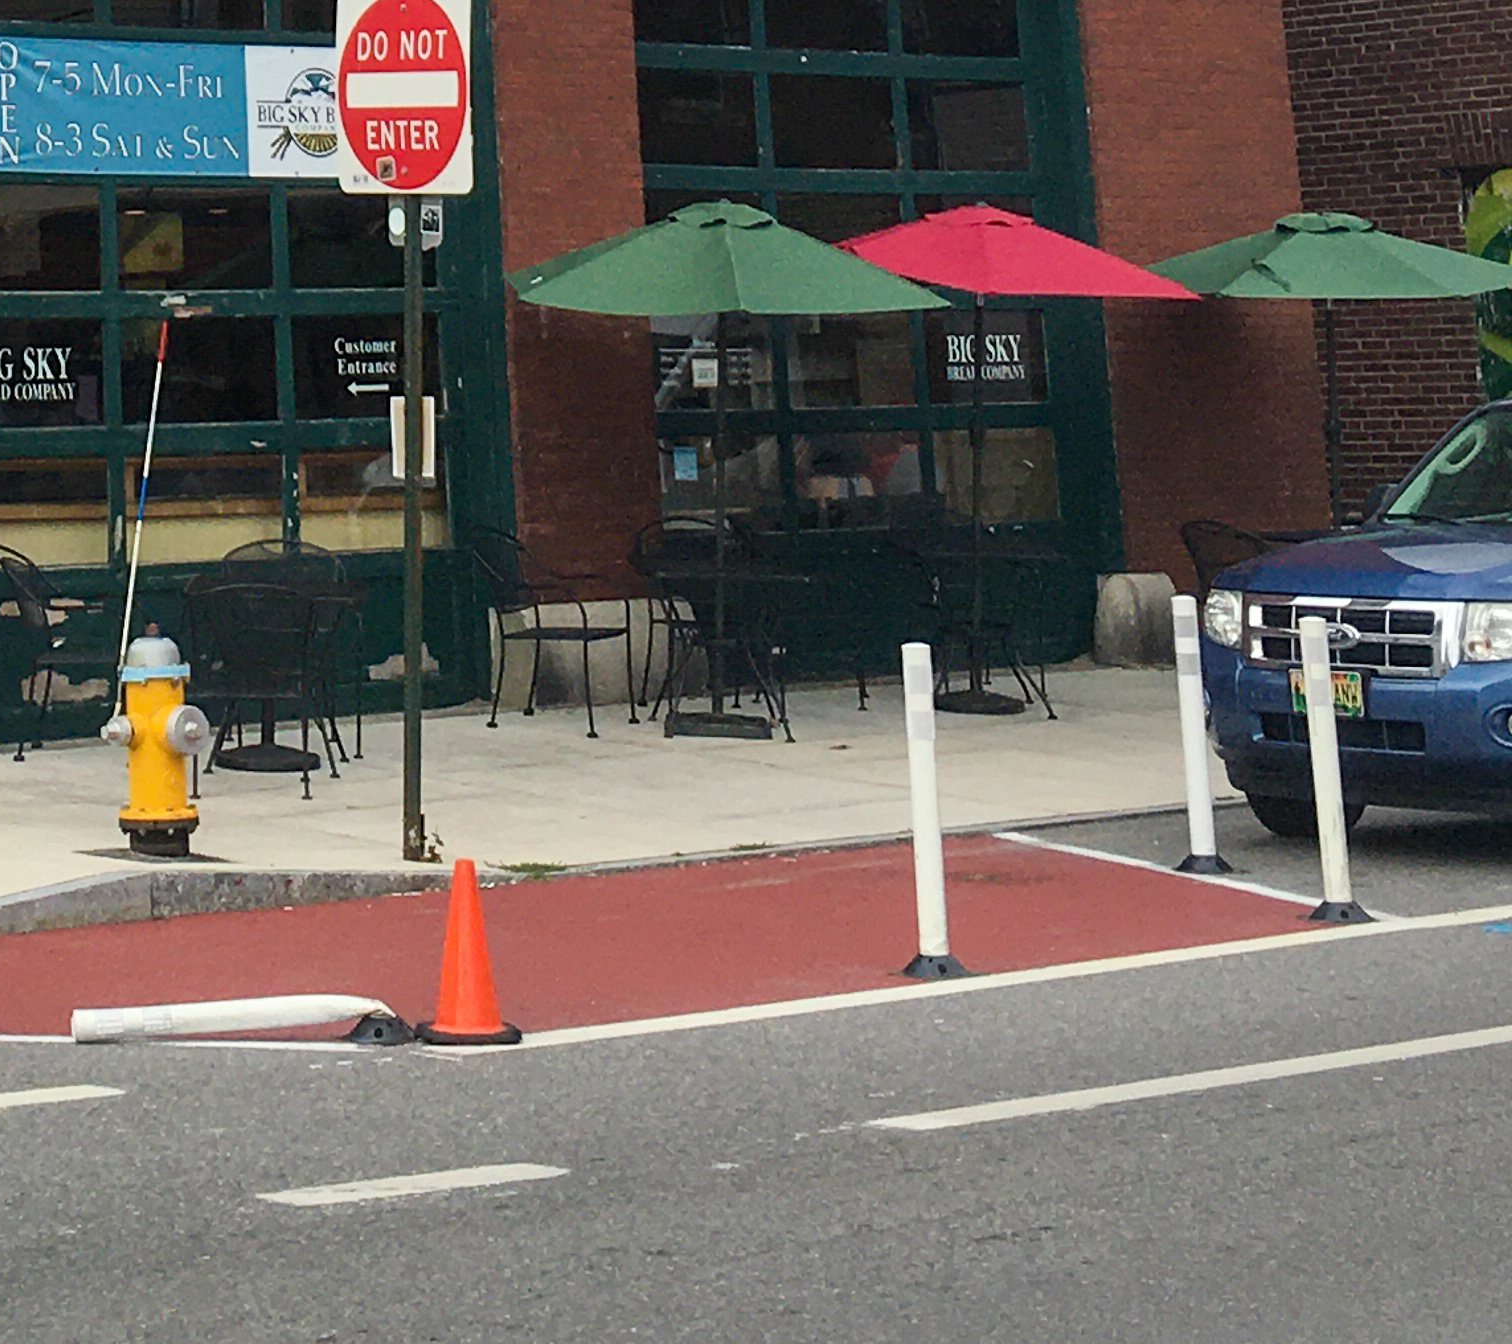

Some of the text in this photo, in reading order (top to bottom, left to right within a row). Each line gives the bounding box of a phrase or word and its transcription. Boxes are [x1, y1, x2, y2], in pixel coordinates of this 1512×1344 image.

[356, 29, 448, 61] DO NOT
[33, 60, 82, 95] 7-5
[257, 104, 285, 123] BIG
[287, 105, 322, 124] SKY
[294, 124, 336, 132] COMPAN
[366, 119, 440, 151] ENTER
[35, 123, 83, 157] 8-3
[155, 136, 174, 159] &
[334, 337, 396, 354] Customer
[985, 334, 1021, 363] SKY
[22, 346, 72, 381] SKY
[337, 358, 396, 376] Entrance
[980, 364, 1025, 380] COMPANY
[14, 382, 76, 401] COMPANY
